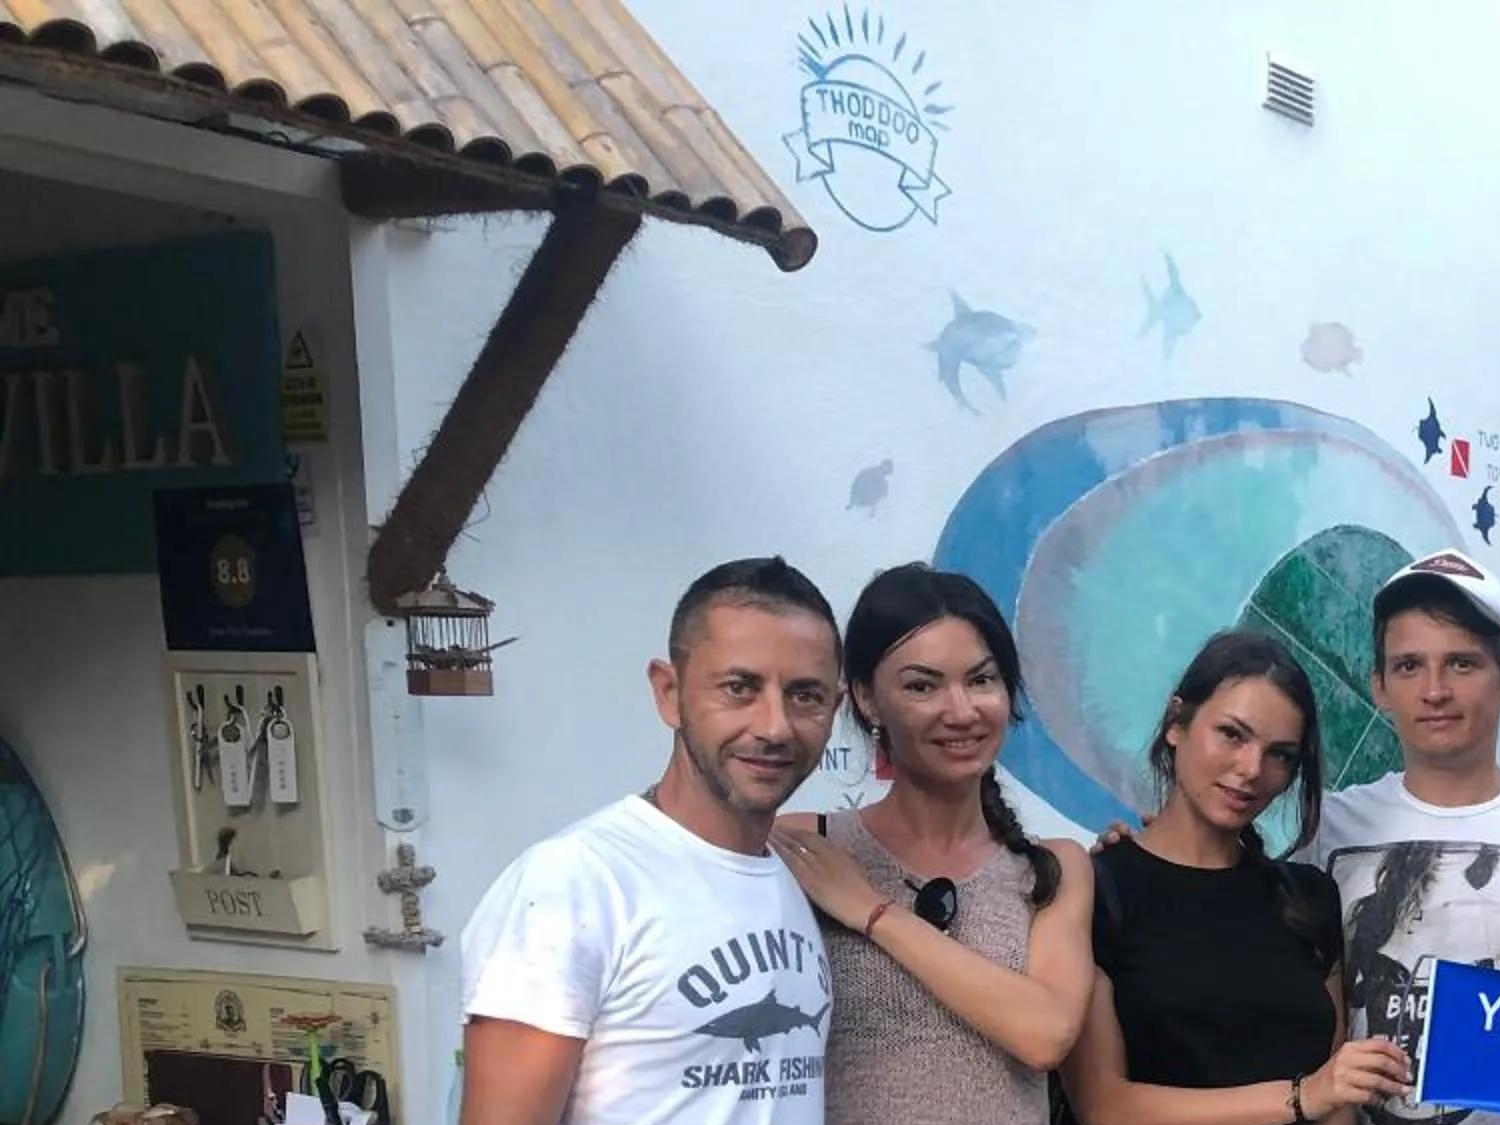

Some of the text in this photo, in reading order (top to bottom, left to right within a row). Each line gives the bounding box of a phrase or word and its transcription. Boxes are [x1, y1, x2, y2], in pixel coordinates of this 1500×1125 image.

[814, 87, 920, 145] THODDOO
[848, 119, 889, 151] map
[0, 356, 232, 478] VILLA
[1477, 429, 1500, 451] TWO
[217, 558, 251, 585] 8.8
[206, 888, 264, 917] POST
[681, 1059, 771, 1089] SHARK
